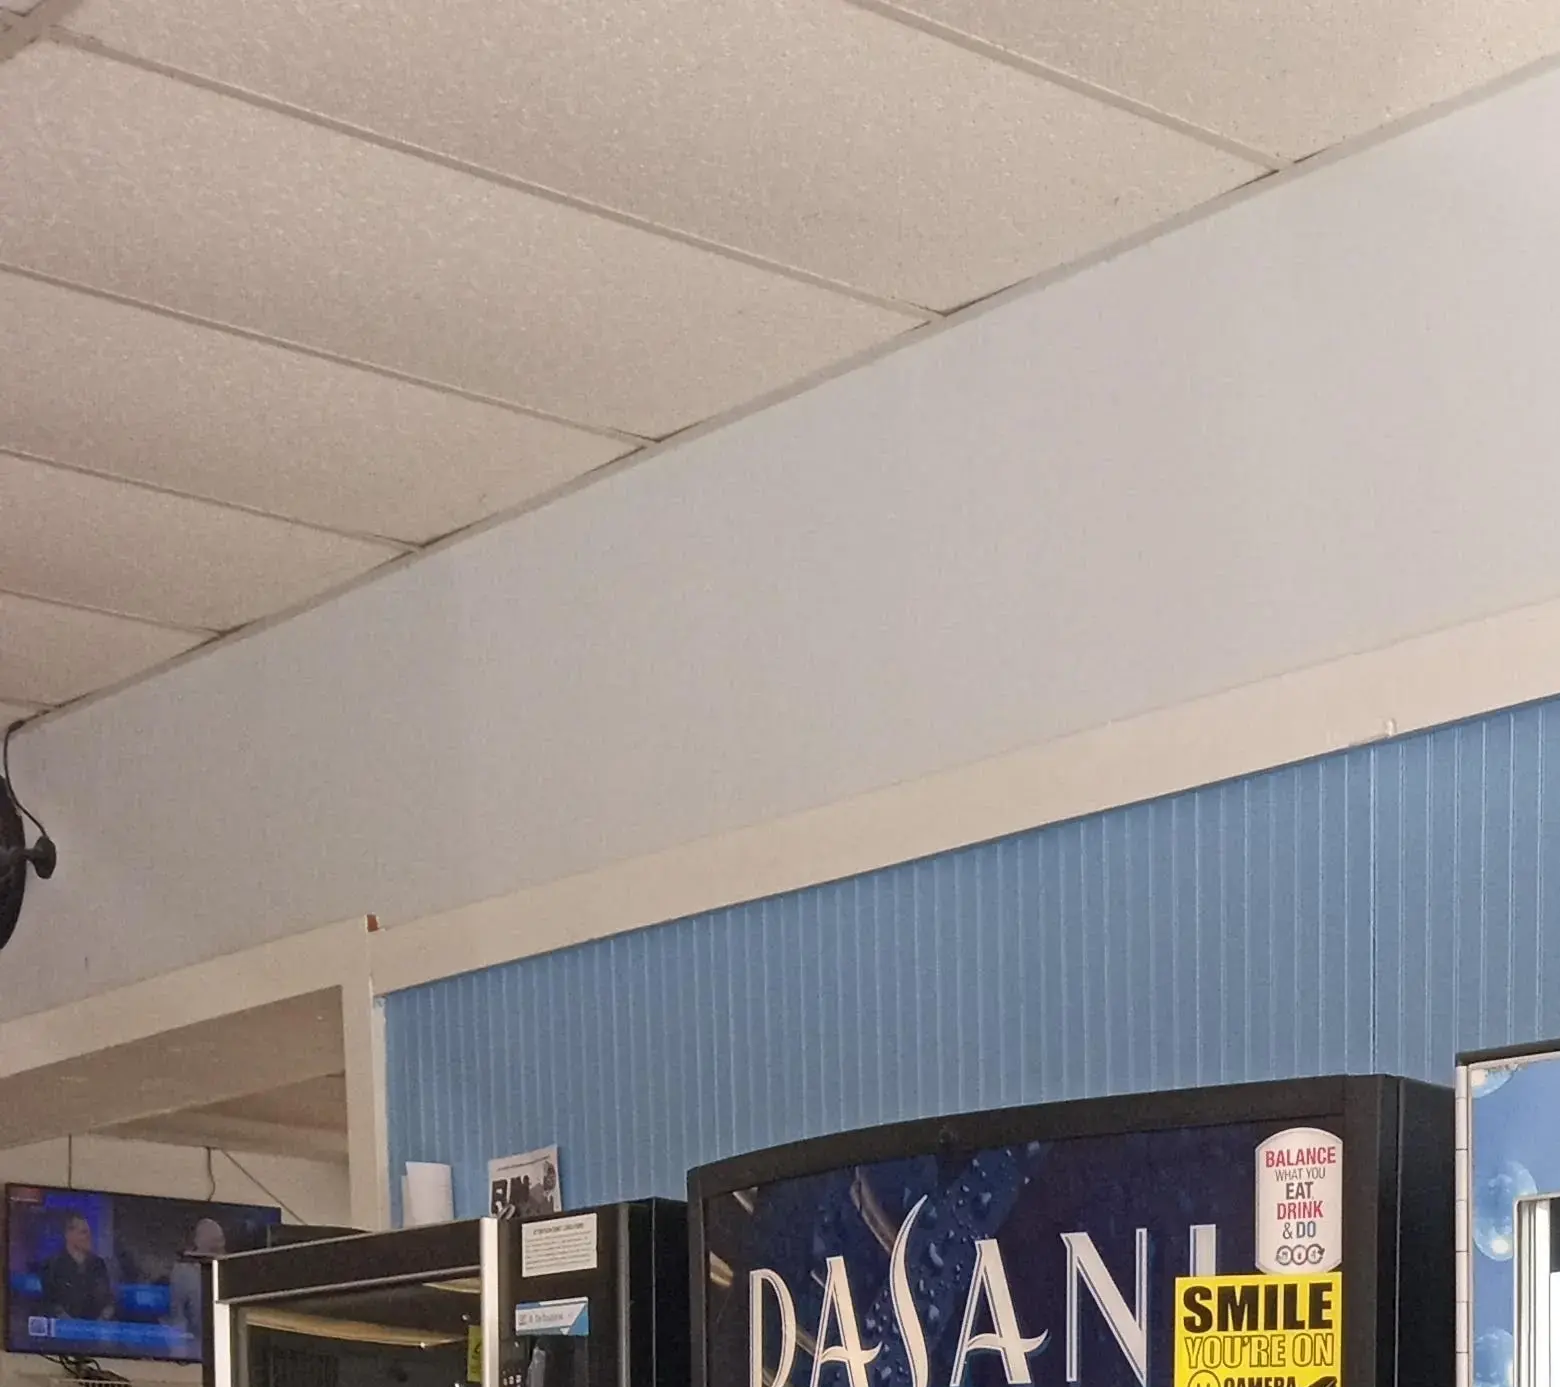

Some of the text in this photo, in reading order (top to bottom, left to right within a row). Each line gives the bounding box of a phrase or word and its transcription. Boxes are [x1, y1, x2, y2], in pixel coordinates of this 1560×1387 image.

[1265, 1147, 1336, 1168] BALANCE
[1275, 1167, 1326, 1182] WHAT YOU
[1277, 1200, 1323, 1220] DRINK
[1282, 1221, 1317, 1239] & DO
[1183, 1282, 1333, 1333] SMILE
[1185, 1333, 1334, 1369] YOU'RE ON
